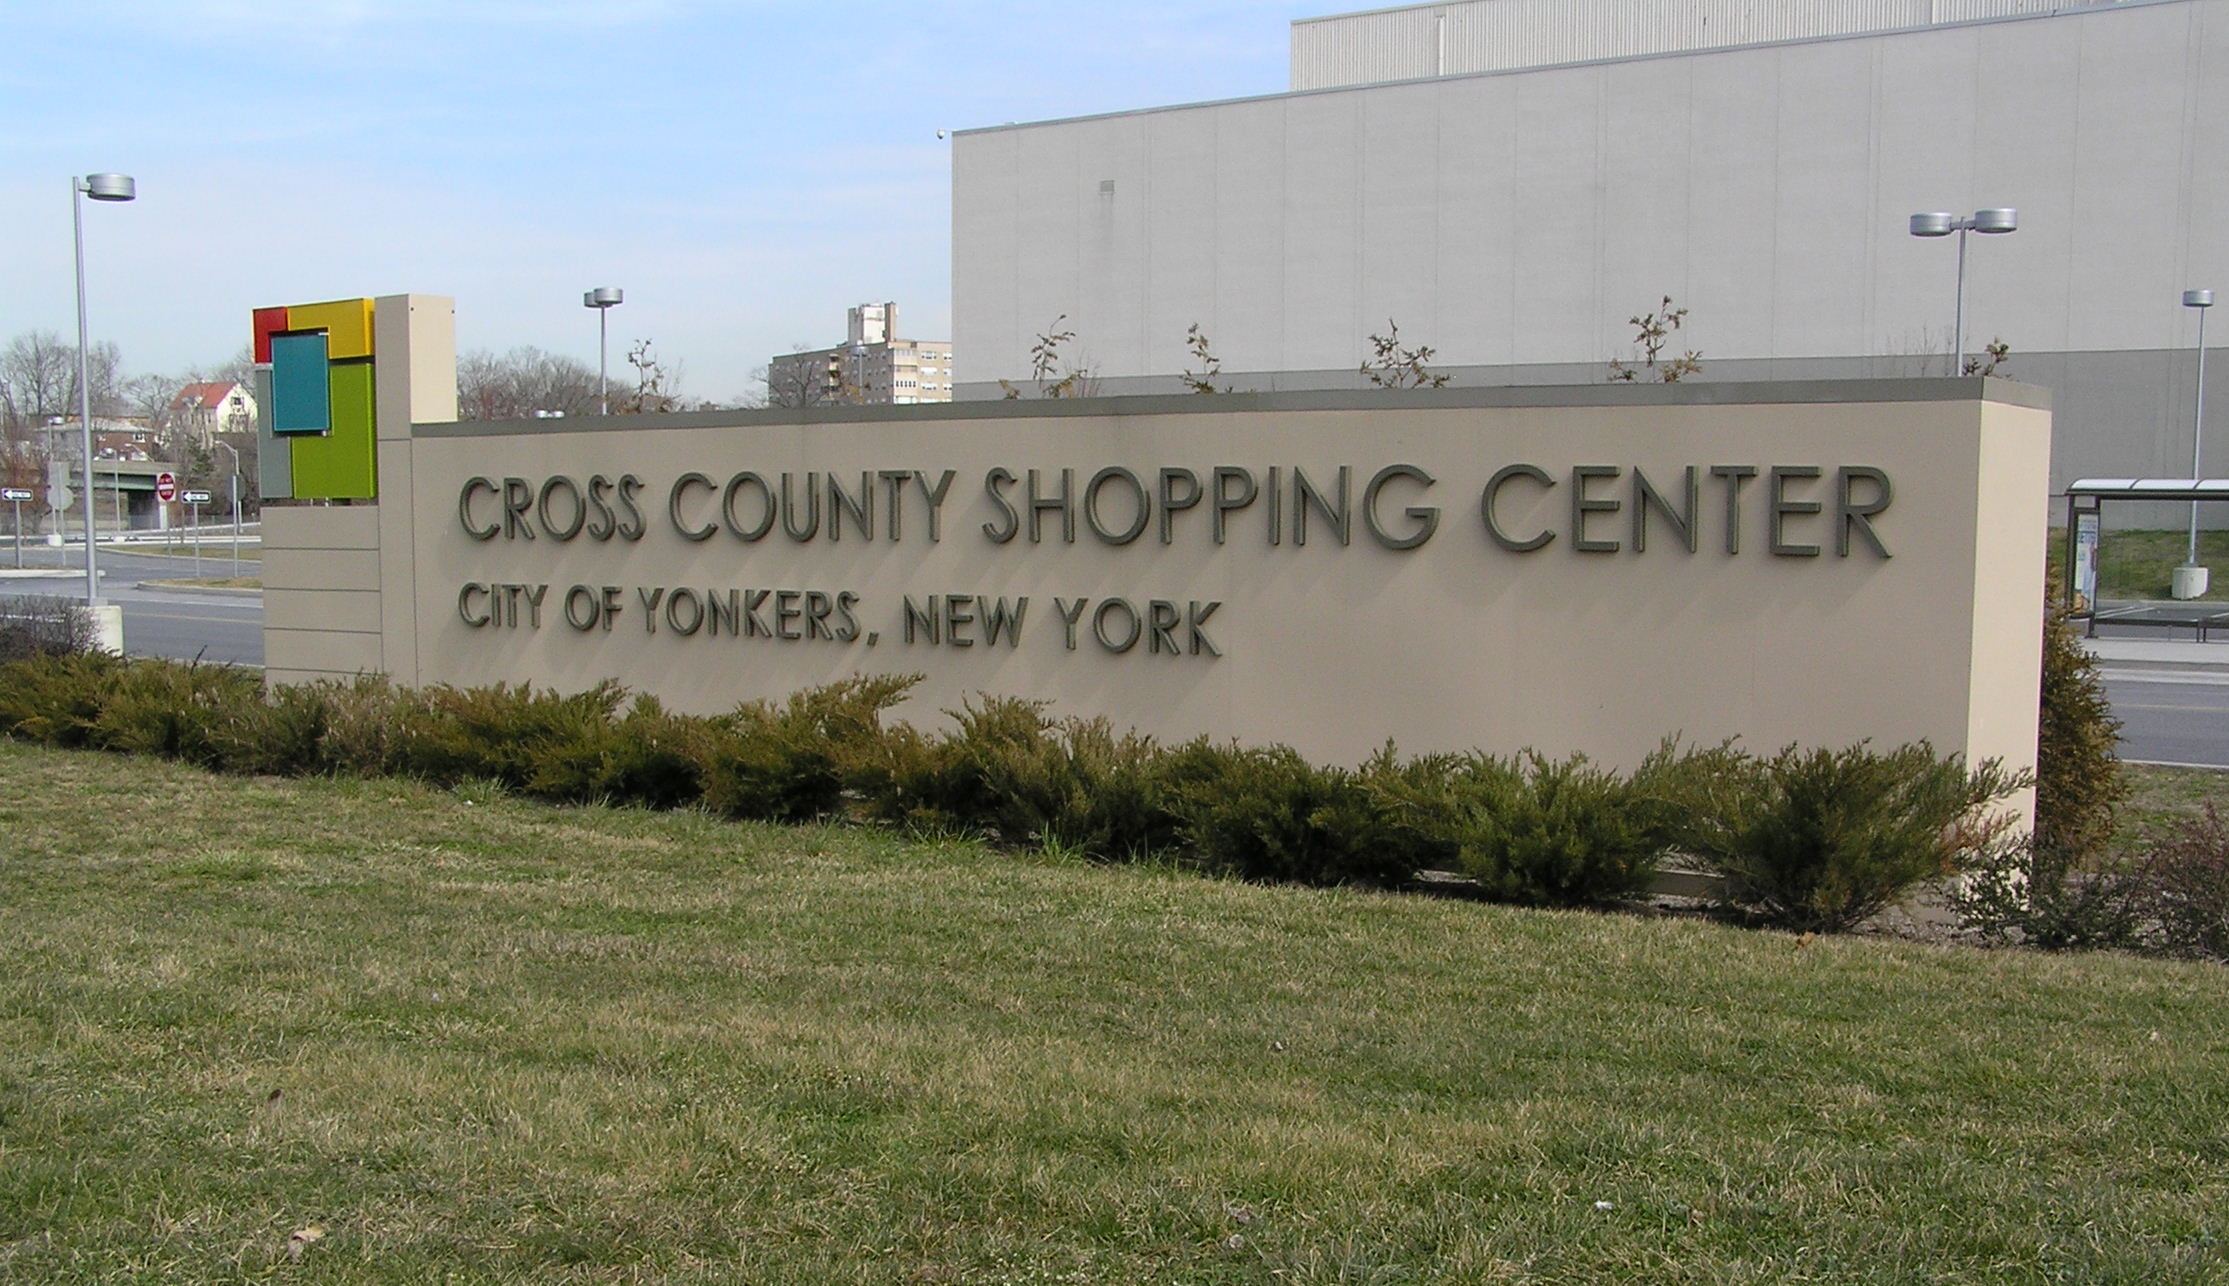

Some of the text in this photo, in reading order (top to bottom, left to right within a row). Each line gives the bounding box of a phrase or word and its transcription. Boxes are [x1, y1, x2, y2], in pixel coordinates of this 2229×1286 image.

[458, 464, 1895, 558] CROSS COUNTY SHOPPING CENTER
[458, 582, 1222, 658] CITY OF YONKERS, NEW YORK
